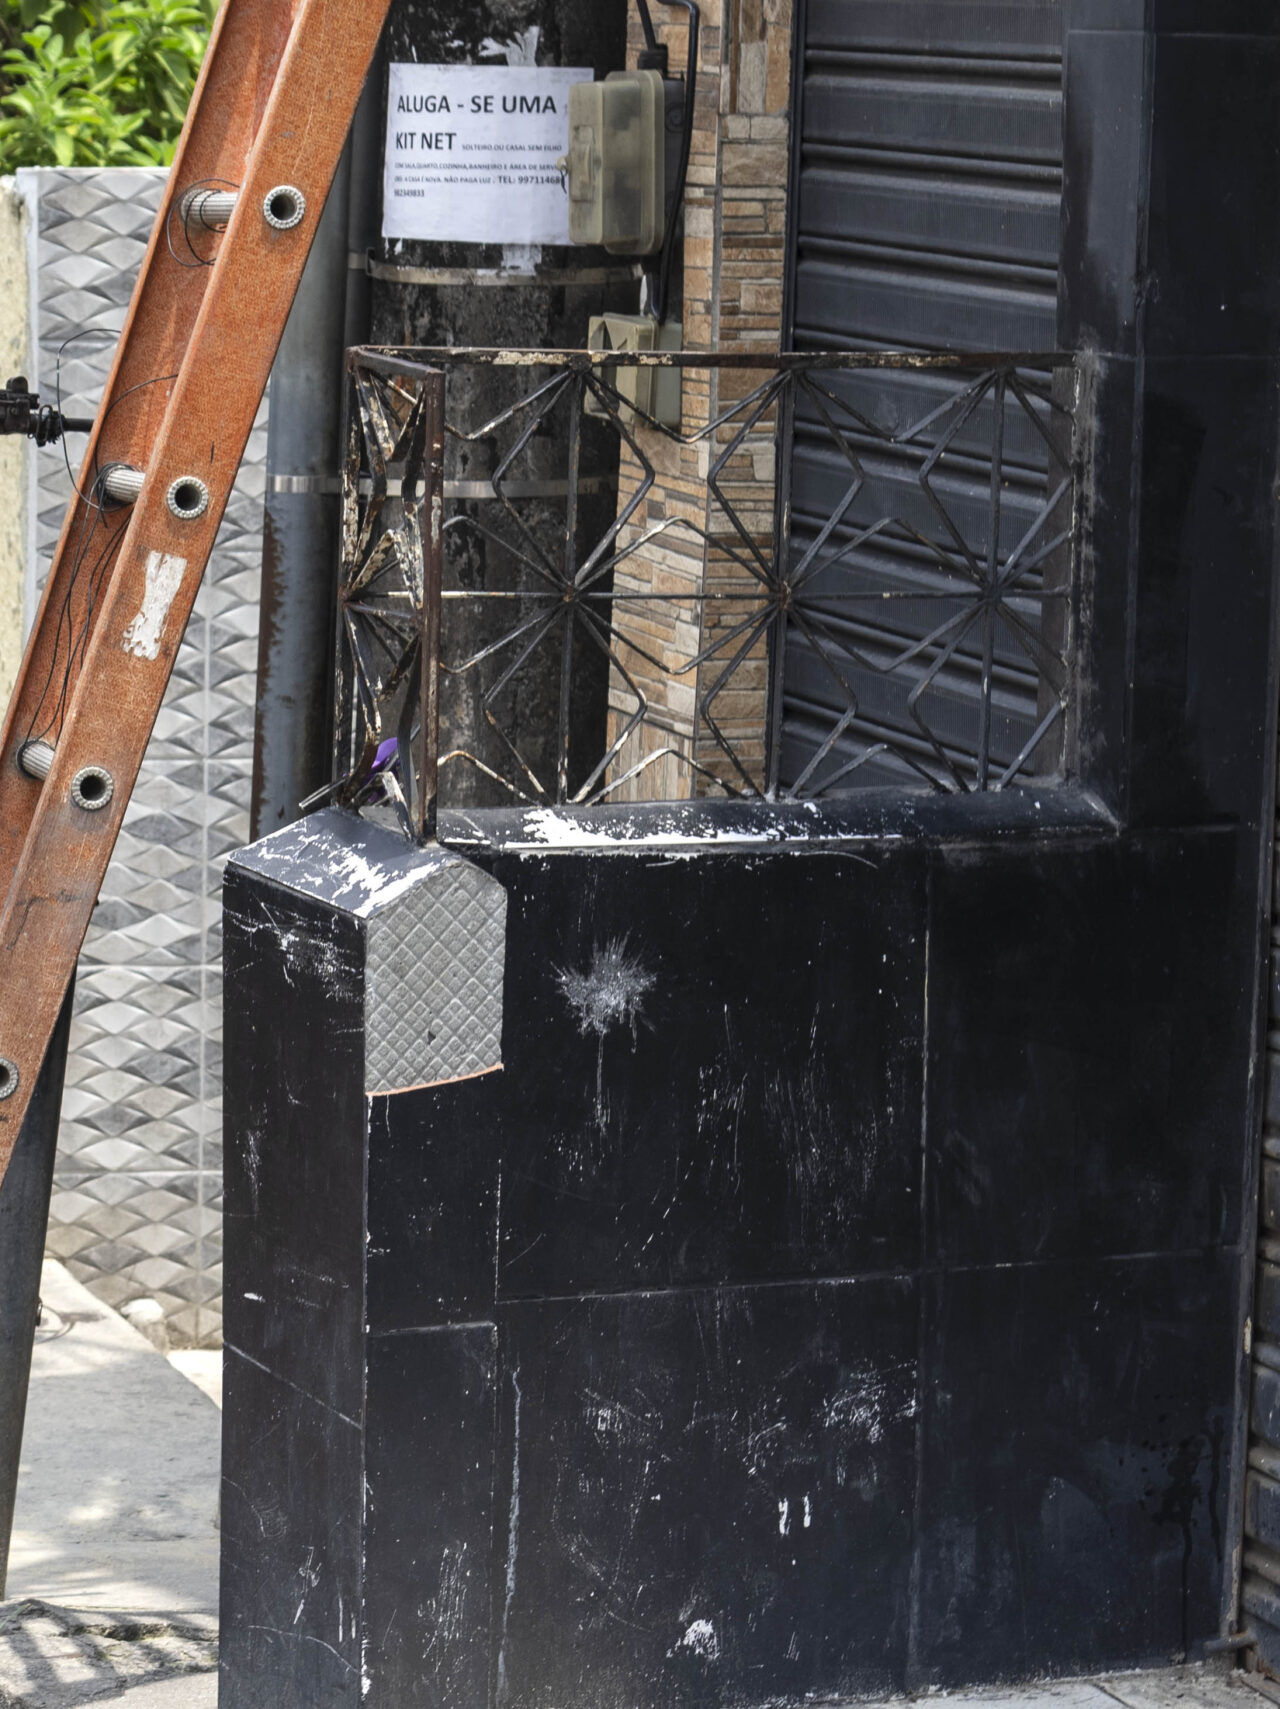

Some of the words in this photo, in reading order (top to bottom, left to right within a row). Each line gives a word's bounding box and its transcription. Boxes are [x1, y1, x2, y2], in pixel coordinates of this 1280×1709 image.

[397, 95, 451, 113] ALUGA
[470, 95, 495, 113] SE
[502, 95, 557, 114] UMA
[396, 132, 417, 150] KIT
[421, 132, 457, 150] NET
